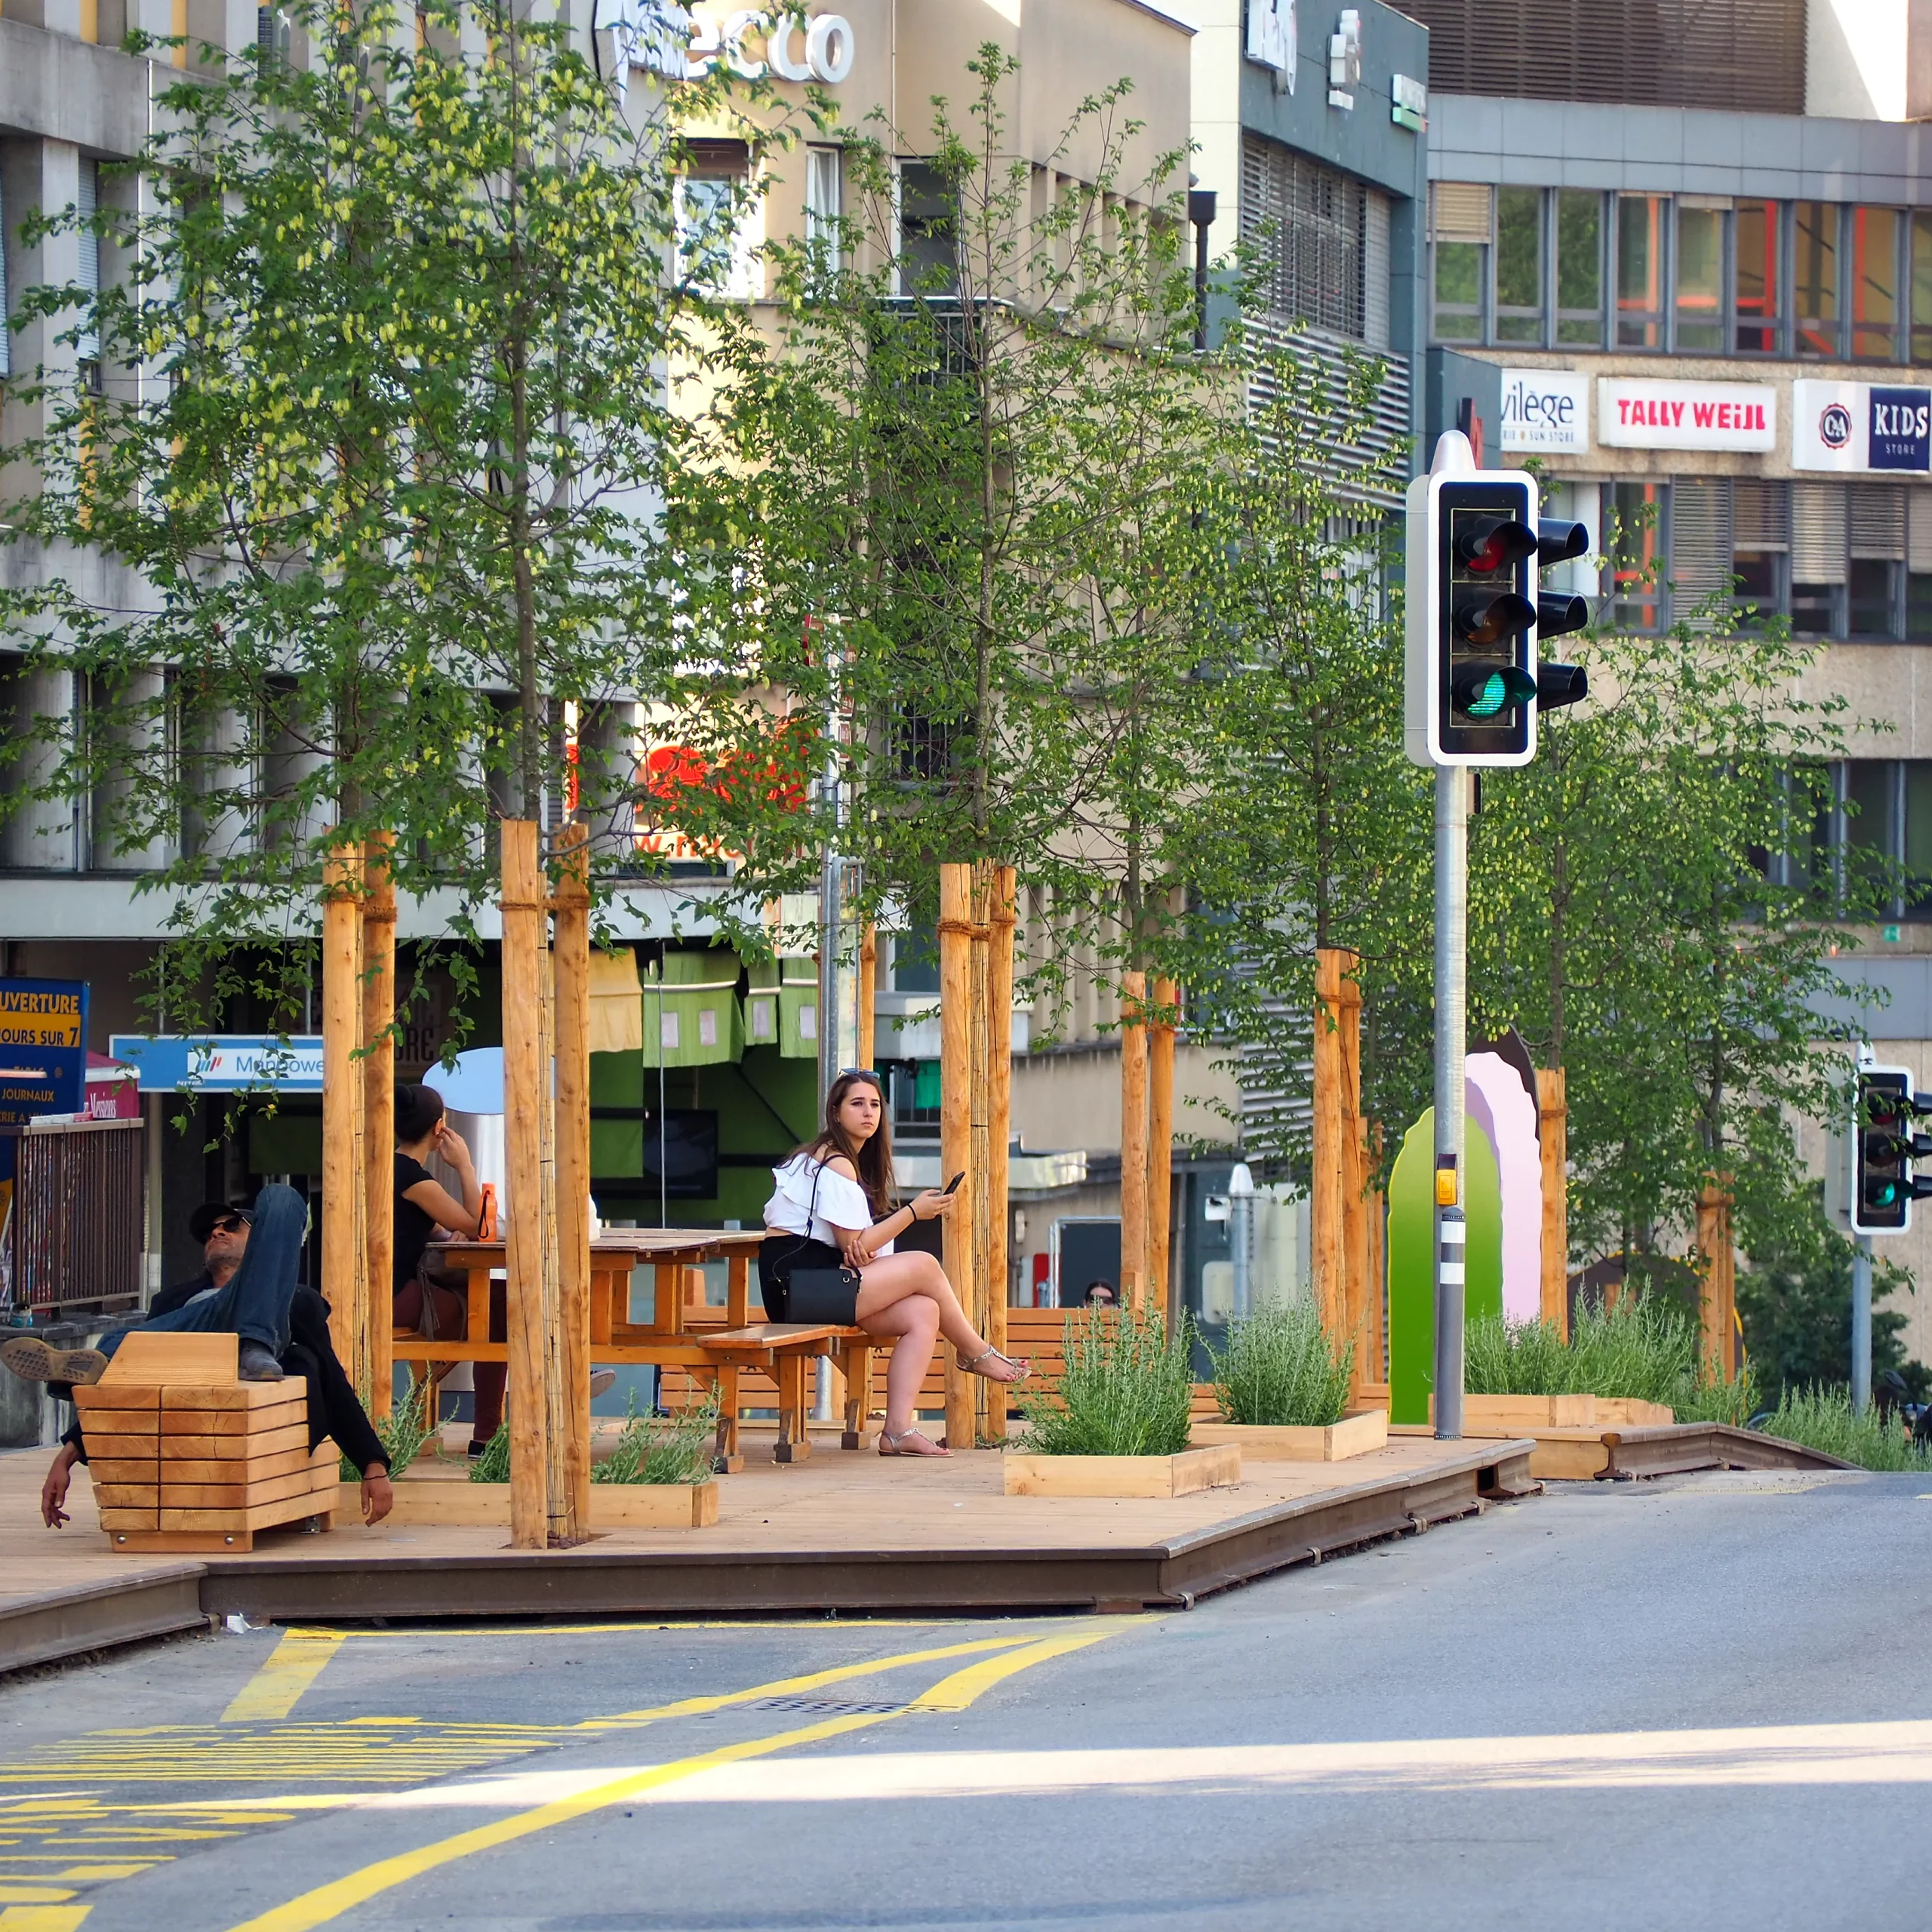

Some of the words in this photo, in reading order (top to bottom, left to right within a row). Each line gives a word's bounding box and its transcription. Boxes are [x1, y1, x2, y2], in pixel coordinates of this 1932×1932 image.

[1617, 399, 1684, 427] TALLY
[1875, 403, 1928, 439] KIDS
[1885, 444, 1915, 455] STORE
[0, 1028, 35, 1044] OURS
[41, 1030, 63, 1045] SUR
[69, 1027, 78, 1046] 7
[2, 1088, 54, 1102] JOURNAUX
